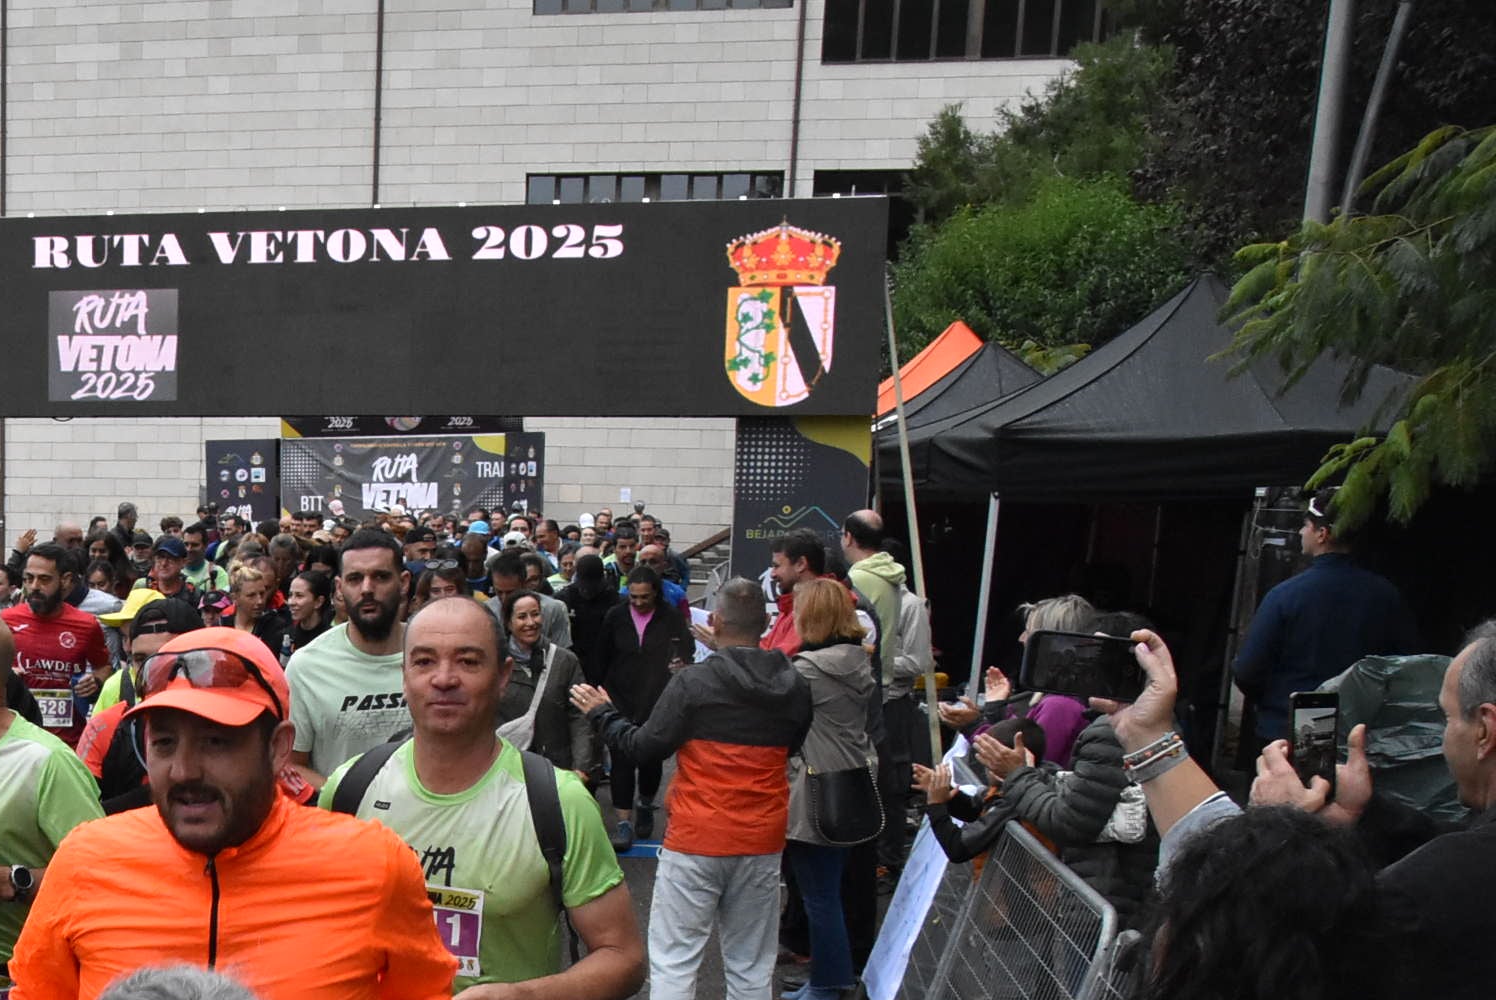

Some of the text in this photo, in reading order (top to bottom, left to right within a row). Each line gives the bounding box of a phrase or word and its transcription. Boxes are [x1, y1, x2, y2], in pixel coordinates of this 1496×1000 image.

[32, 223, 625, 269] RUTA VETONA 2025
[72, 290, 148, 334] RUTA
[57, 334, 177, 372] VETONA
[70, 371, 155, 401] 2025
[371, 452, 418, 483] RUTA
[300, 495, 324, 512] BTT
[444, 894, 476, 910] 2025
